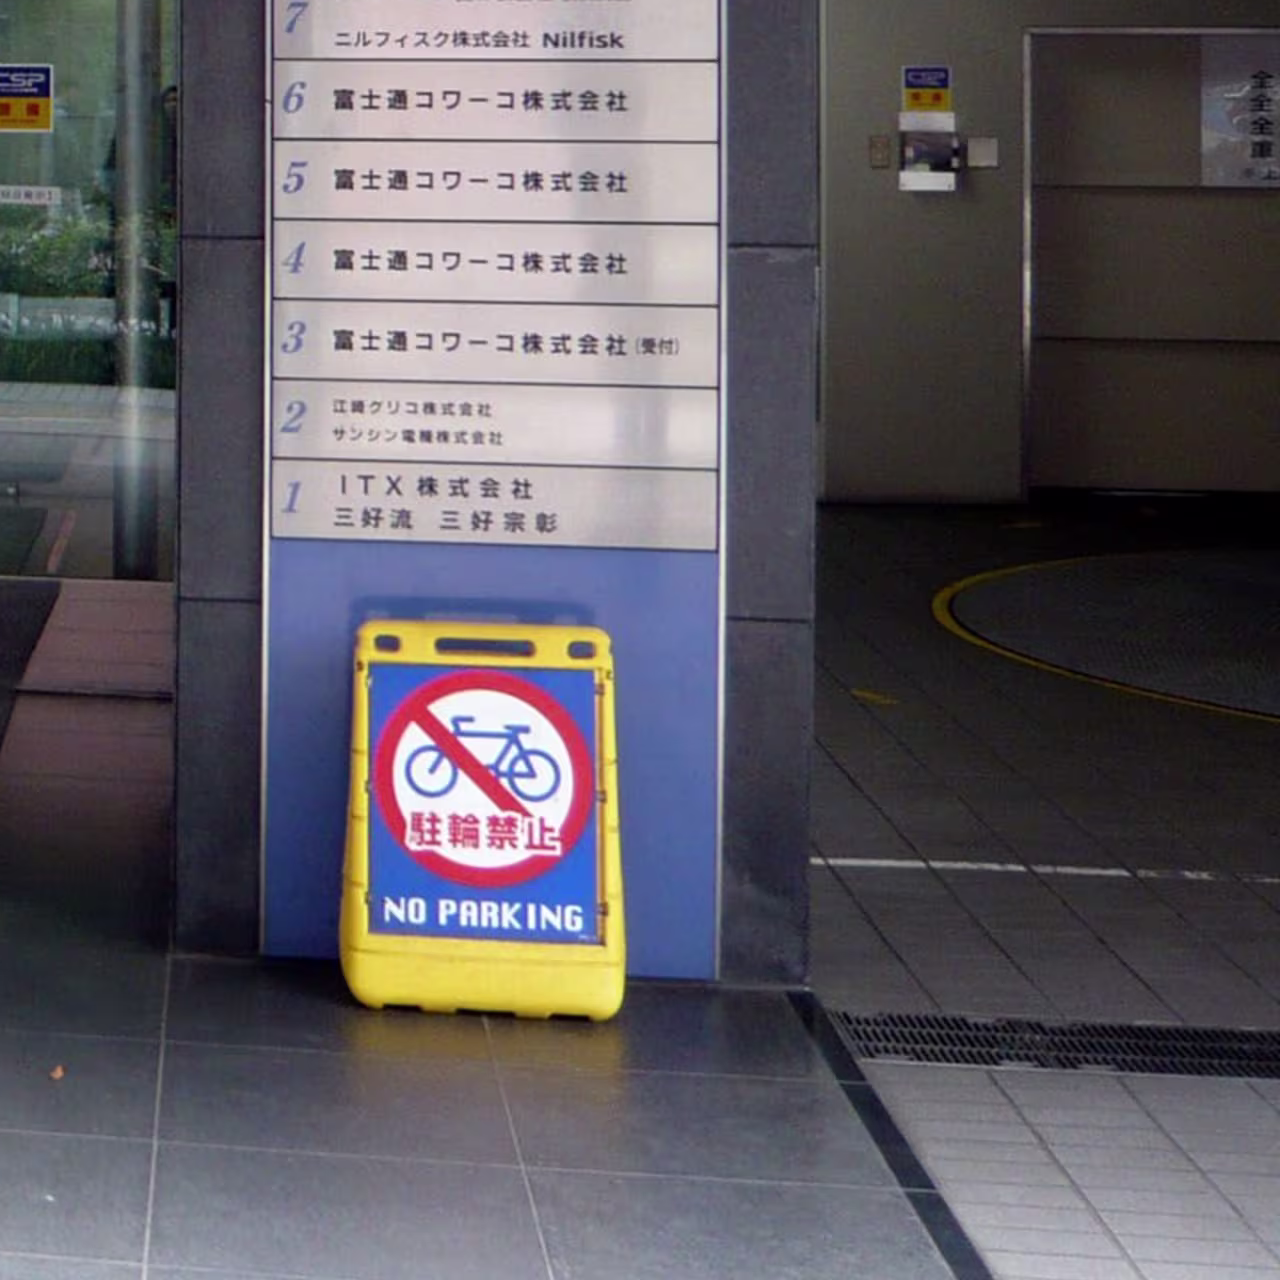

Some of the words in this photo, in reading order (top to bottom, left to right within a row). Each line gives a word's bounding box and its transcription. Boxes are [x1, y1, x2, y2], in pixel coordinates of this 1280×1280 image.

[284, 1, 308, 34] 7
[334, 30, 530, 49] ニルフィスク株式会社
[542, 30, 625, 50] Nilfisk
[282, 80, 306, 114] 6
[333, 88, 629, 112] 富士通コワーコ株式会社
[282, 161, 308, 194] 5
[333, 168, 629, 193] 富士通コワーコ株式会社
[281, 241, 306, 274] 4
[333, 248, 629, 275] 富士通コワーコ株式会社
[281, 321, 306, 354] 3
[333, 328, 629, 357] 富士通コワーコ株式会社
[281, 401, 307, 434] 2
[332, 425, 504, 447] サンシン電機株式会社
[281, 481, 303, 514] 1
[408, 810, 559, 854] 駐輪禁止
[383, 895, 427, 925] NO
[438, 897, 585, 933] PARKING
